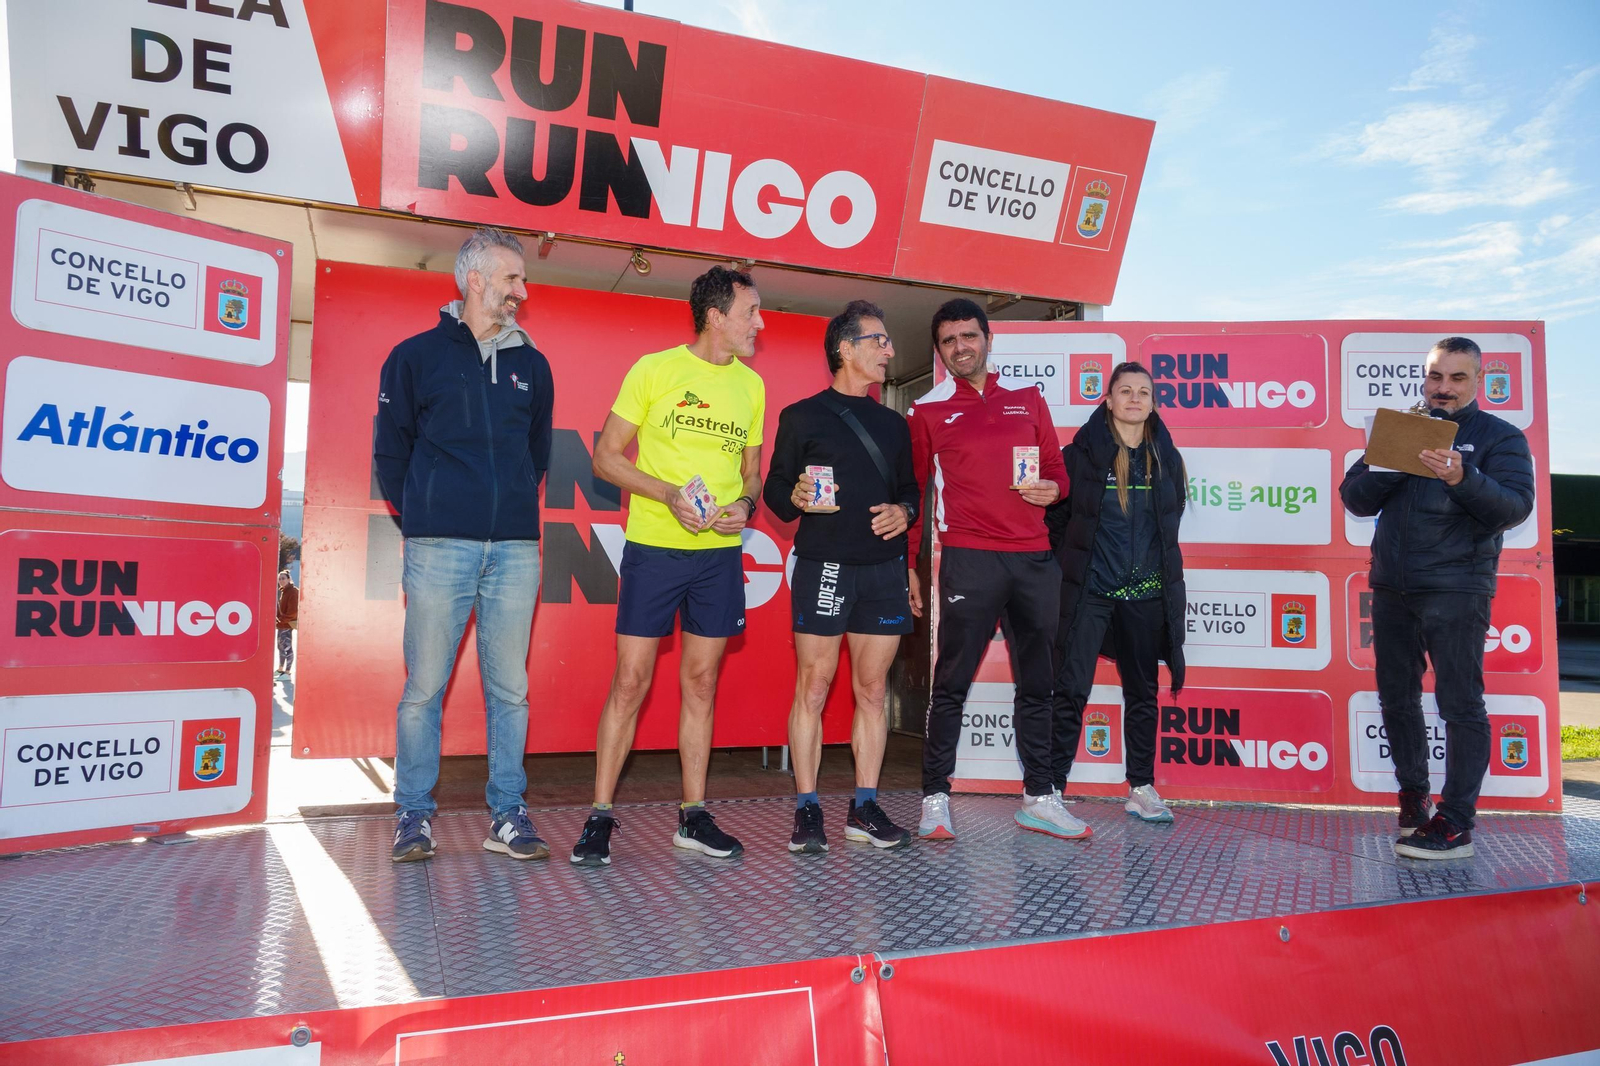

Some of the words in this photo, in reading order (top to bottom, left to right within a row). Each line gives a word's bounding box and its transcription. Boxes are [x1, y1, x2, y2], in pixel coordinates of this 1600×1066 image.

[131, 27, 232, 95] DE
[421, 0, 668, 128] RUN
[57, 95, 269, 174] VIGO
[939, 160, 1055, 198] CONCELLO
[948, 188, 977, 211] DE
[986, 194, 1037, 221] VIGO
[51, 247, 186, 290] CONCELLO
[67, 273, 101, 296] DE
[111, 282, 171, 308] VIGO
[998, 365, 1056, 377] CELLO
[1151, 353, 1229, 379] RUN
[1355, 364, 1427, 379] CONCEL
[1368, 383, 1393, 397] DE
[17, 403, 259, 464] Atlántico
[675, 413, 748, 440] castrelos
[1184, 477, 1223, 507] áis
[1227, 480, 1246, 511] que
[1250, 485, 1318, 514] auga
[17, 557, 139, 597] RUN
[816, 561, 841, 617] LODEIRO
[1187, 602, 1257, 618] NCELLO
[1186, 619, 1197, 633] E
[1203, 620, 1246, 634] VIGO
[1161, 706, 1240, 736] RUN
[17, 736, 161, 764] CONCELLO
[971, 732, 995, 747] DE
[34, 767, 70, 787] DE
[81, 761, 144, 784] VIGO
